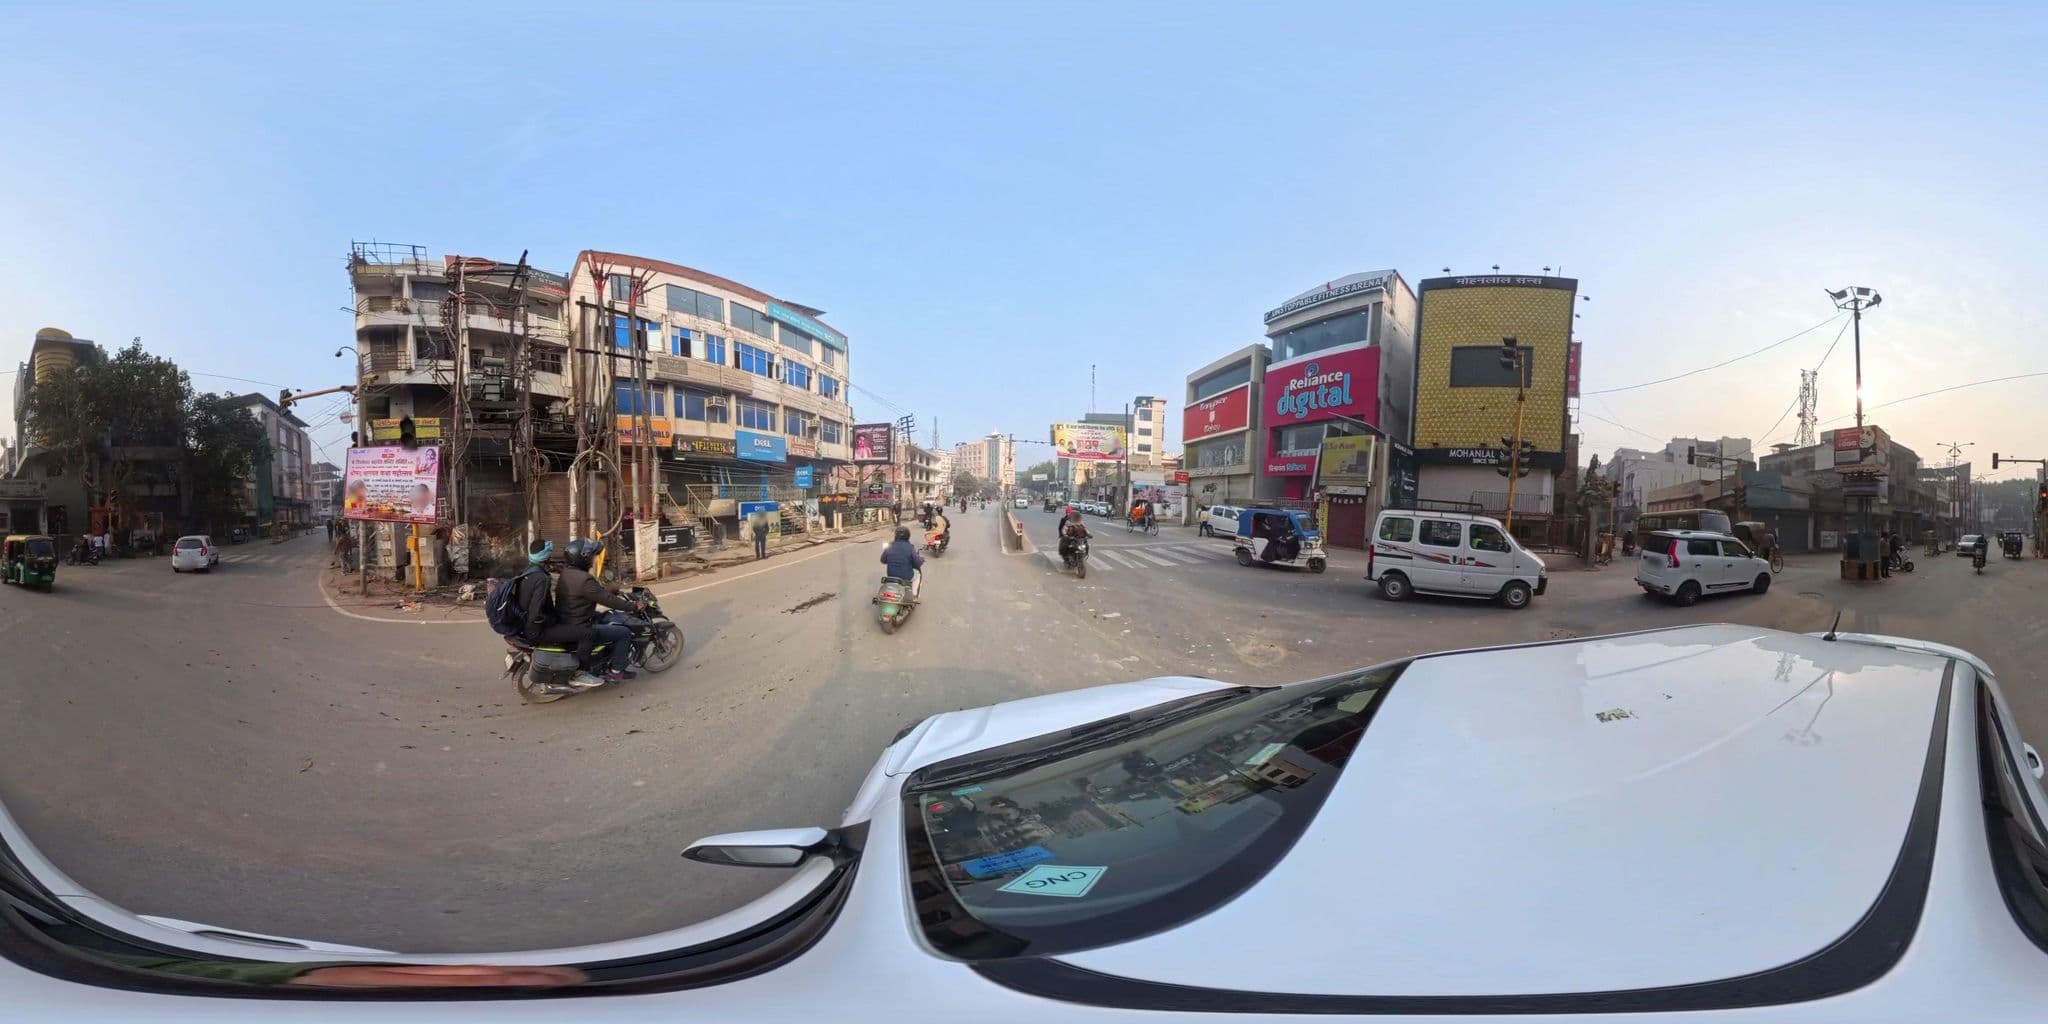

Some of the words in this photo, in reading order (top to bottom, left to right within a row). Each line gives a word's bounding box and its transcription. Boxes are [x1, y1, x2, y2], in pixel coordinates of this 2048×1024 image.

[1456, 276, 1511, 285] मोहनलाल
[1271, 294, 1319, 318] UNSTOPPABLE
[1318, 286, 1350, 299] FITNESS
[1351, 279, 1381, 292] ARENA
[1289, 371, 1344, 391] Reliance
[1277, 373, 1353, 419] digital
[753, 438, 772, 448] DELL
[1448, 449, 1496, 458] MOHANLAL
[1025, 871, 1087, 889] CNG
